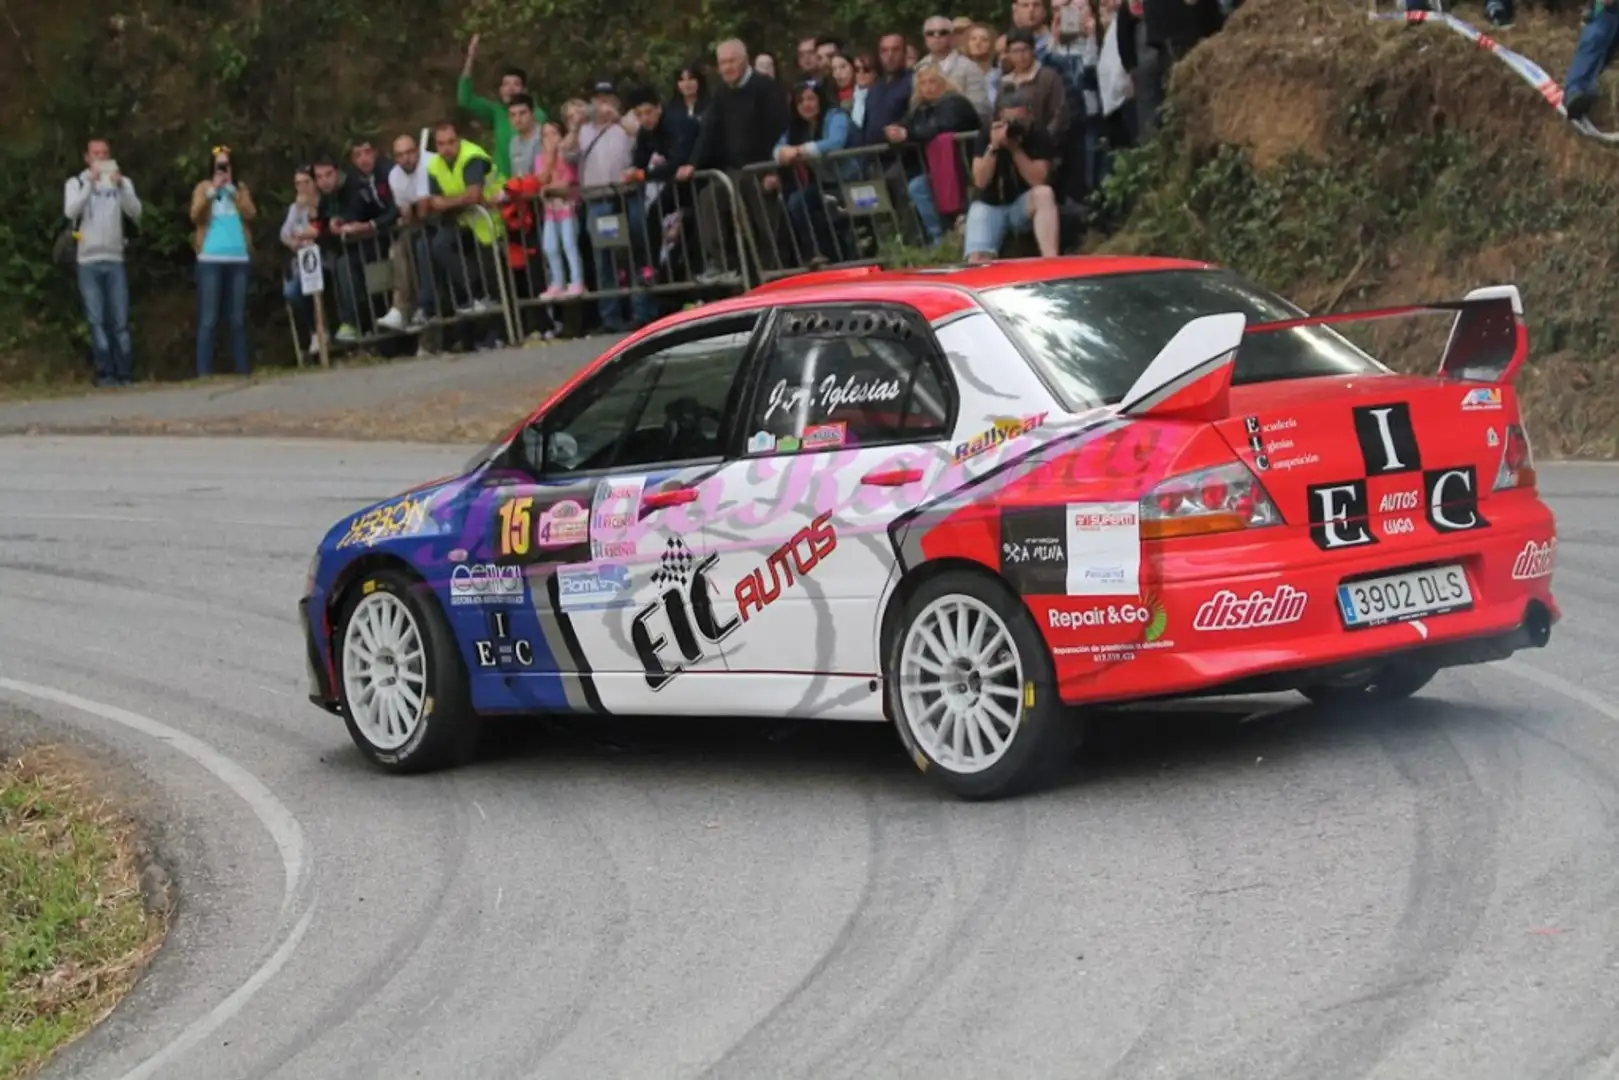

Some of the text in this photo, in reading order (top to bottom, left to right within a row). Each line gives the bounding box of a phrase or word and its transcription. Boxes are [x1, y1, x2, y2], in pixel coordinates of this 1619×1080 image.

[819, 373, 900, 416] Iglesias
[954, 411, 1049, 461] Rallycar
[1378, 489, 1418, 512] AUTOS
[499, 496, 534, 555] 15
[733, 508, 838, 623] AUTOS
[1193, 585, 1307, 630] disiclin
[1354, 571, 1464, 616] 3902 DLS
